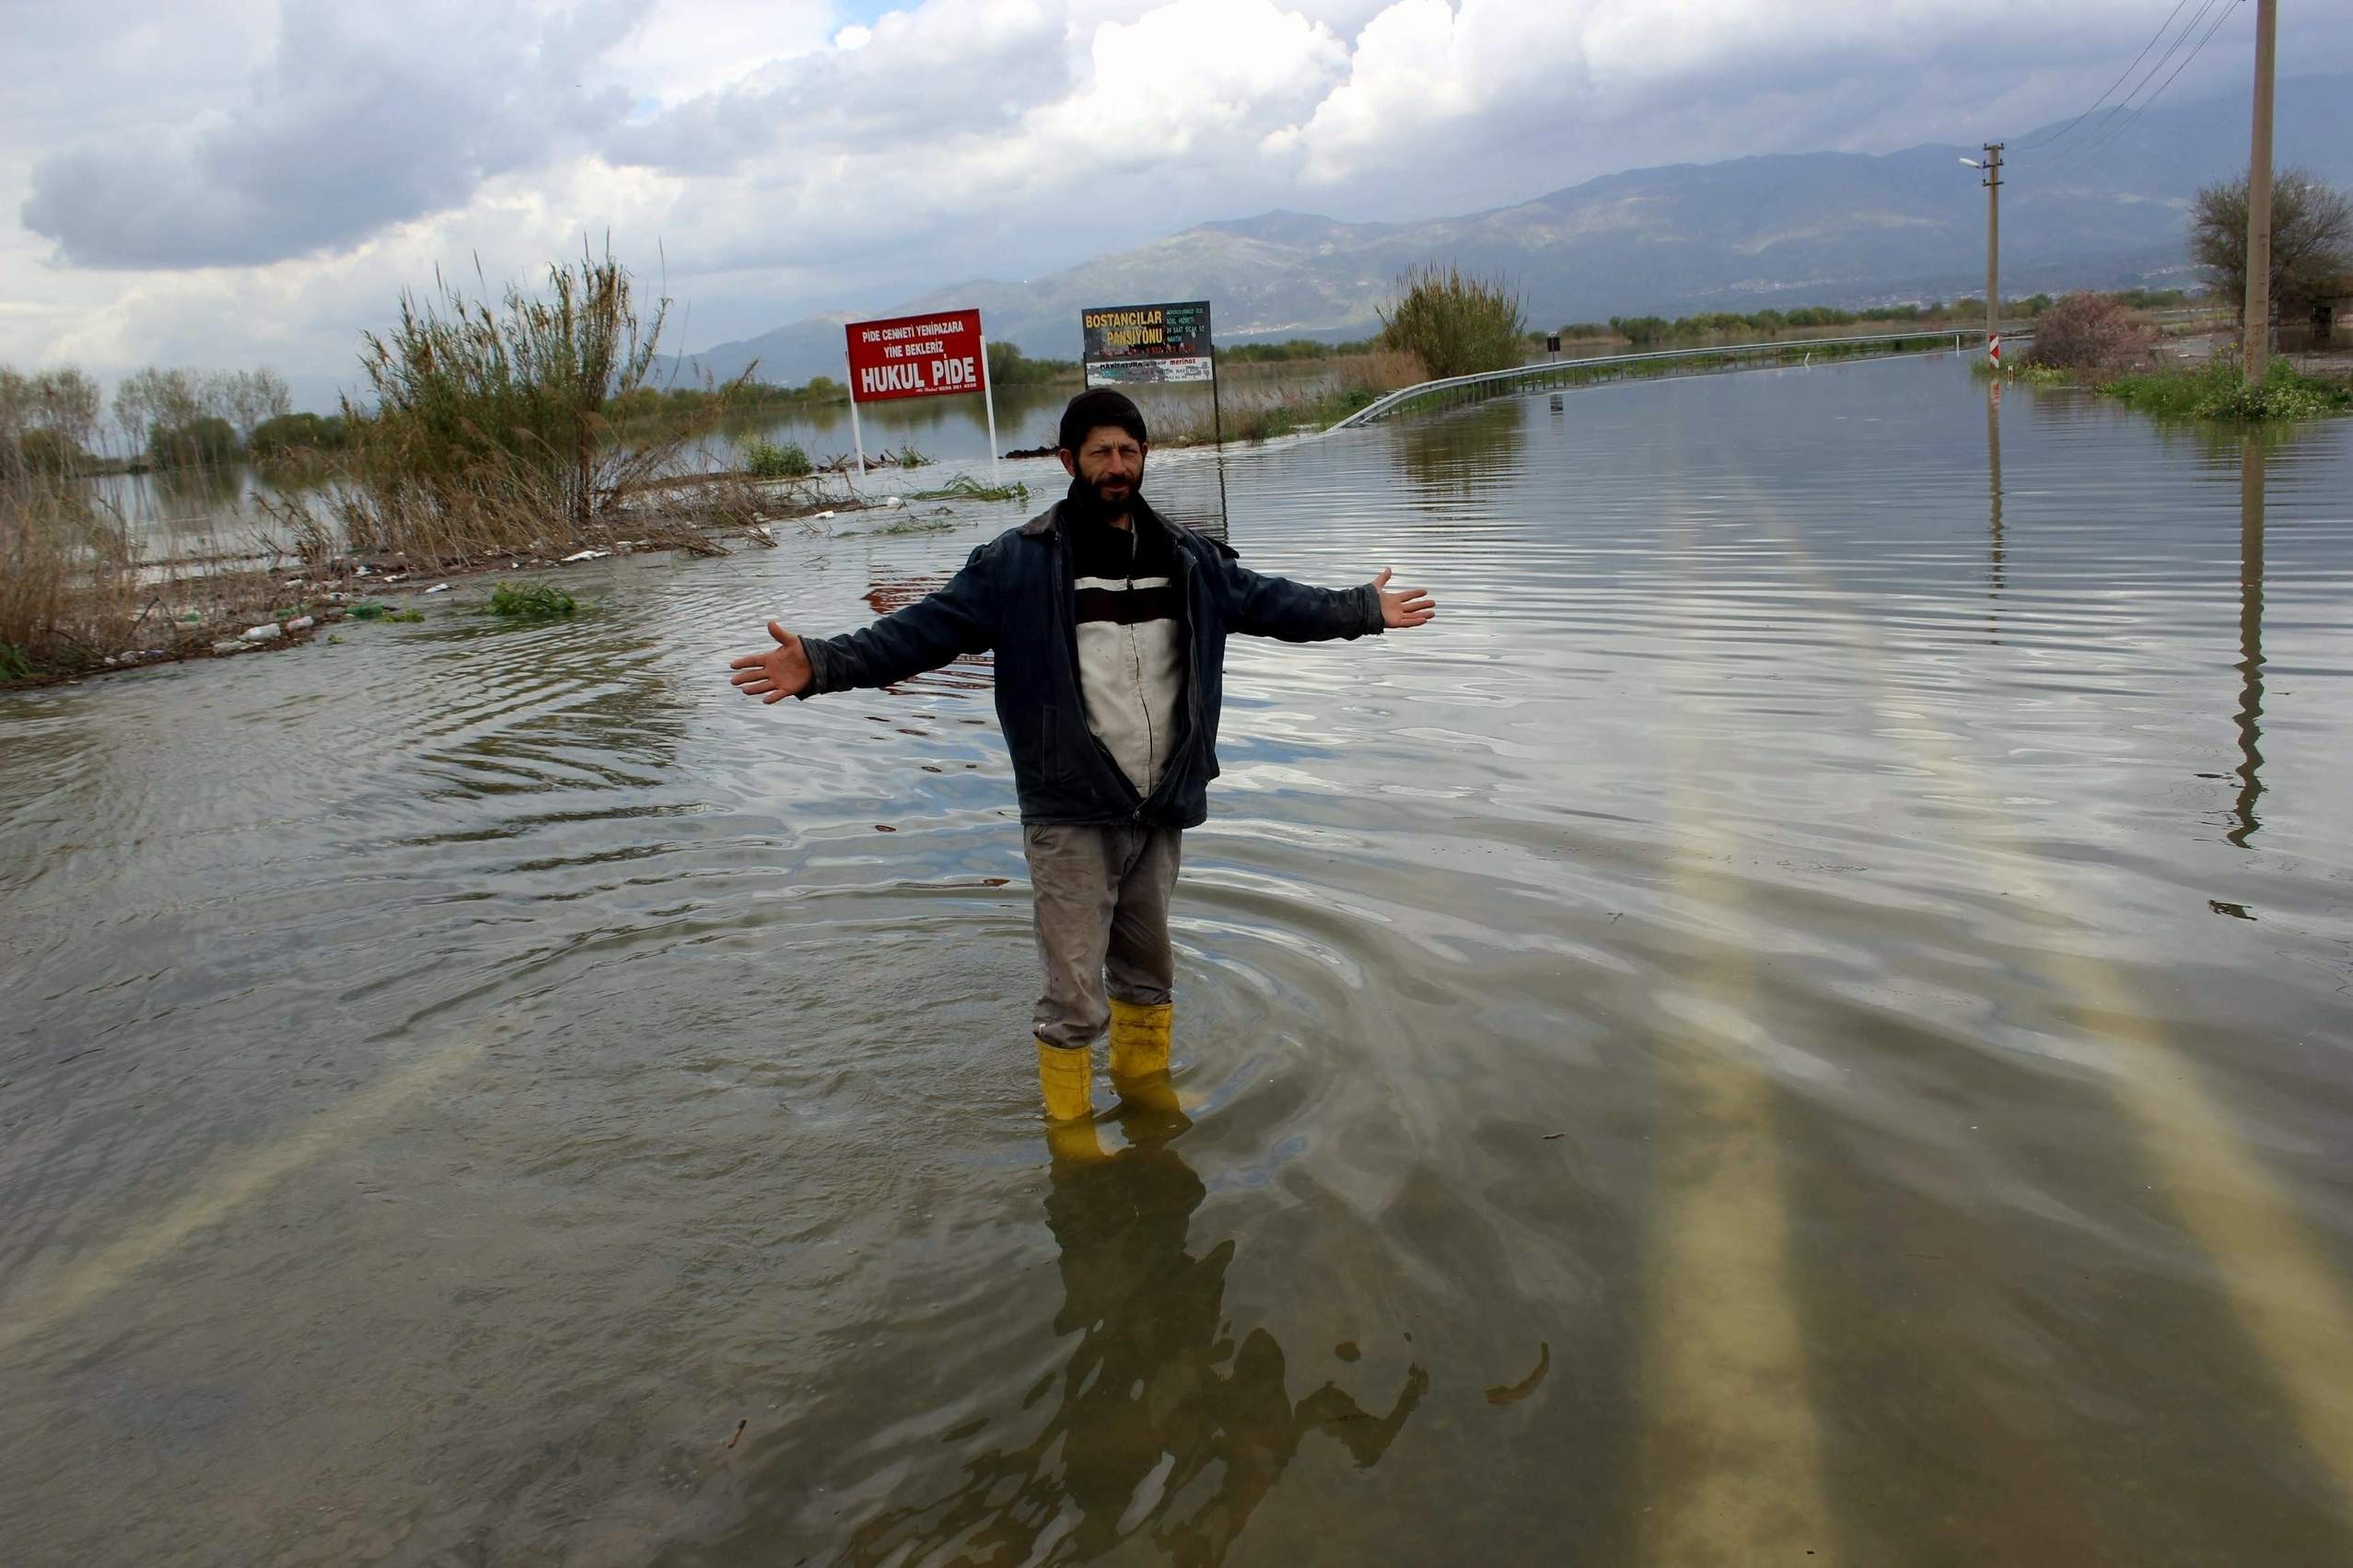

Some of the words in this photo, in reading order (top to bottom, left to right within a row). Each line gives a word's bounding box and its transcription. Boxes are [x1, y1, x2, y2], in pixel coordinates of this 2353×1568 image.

[862, 329, 880, 343] PİDE
[882, 324, 914, 341] CENNETİ
[915, 320, 964, 336] YENİPAZARA
[884, 343, 903, 358] YİNE
[905, 339, 944, 357] BEKLERİZ
[861, 363, 925, 393] HUKUL
[931, 354, 976, 386] PİDE
